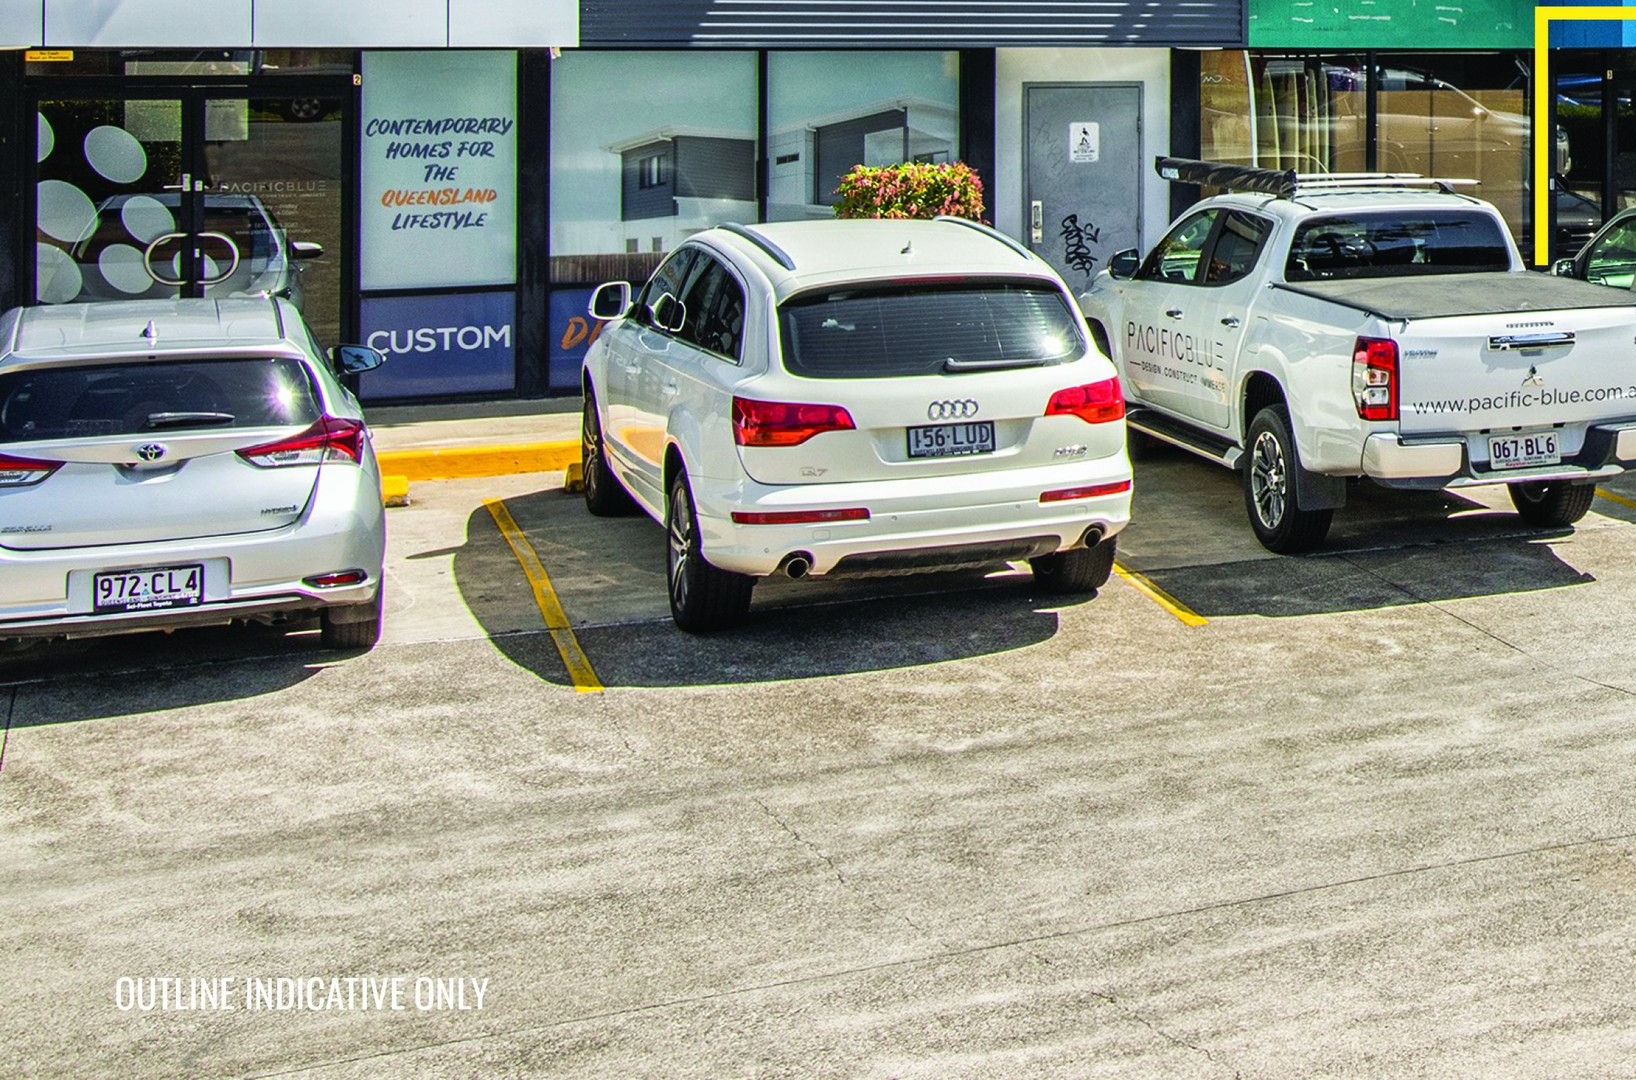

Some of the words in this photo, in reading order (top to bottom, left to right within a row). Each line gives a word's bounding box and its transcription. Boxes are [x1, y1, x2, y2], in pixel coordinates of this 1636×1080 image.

[366, 117, 513, 137] CONTEMPORARY
[386, 141, 452, 159] HOMES
[457, 141, 495, 157] FOR
[424, 164, 458, 182] THE
[381, 188, 497, 208] QUEENSLAND
[392, 211, 487, 230] LIFESTYLE
[367, 325, 511, 354] CUSTOM
